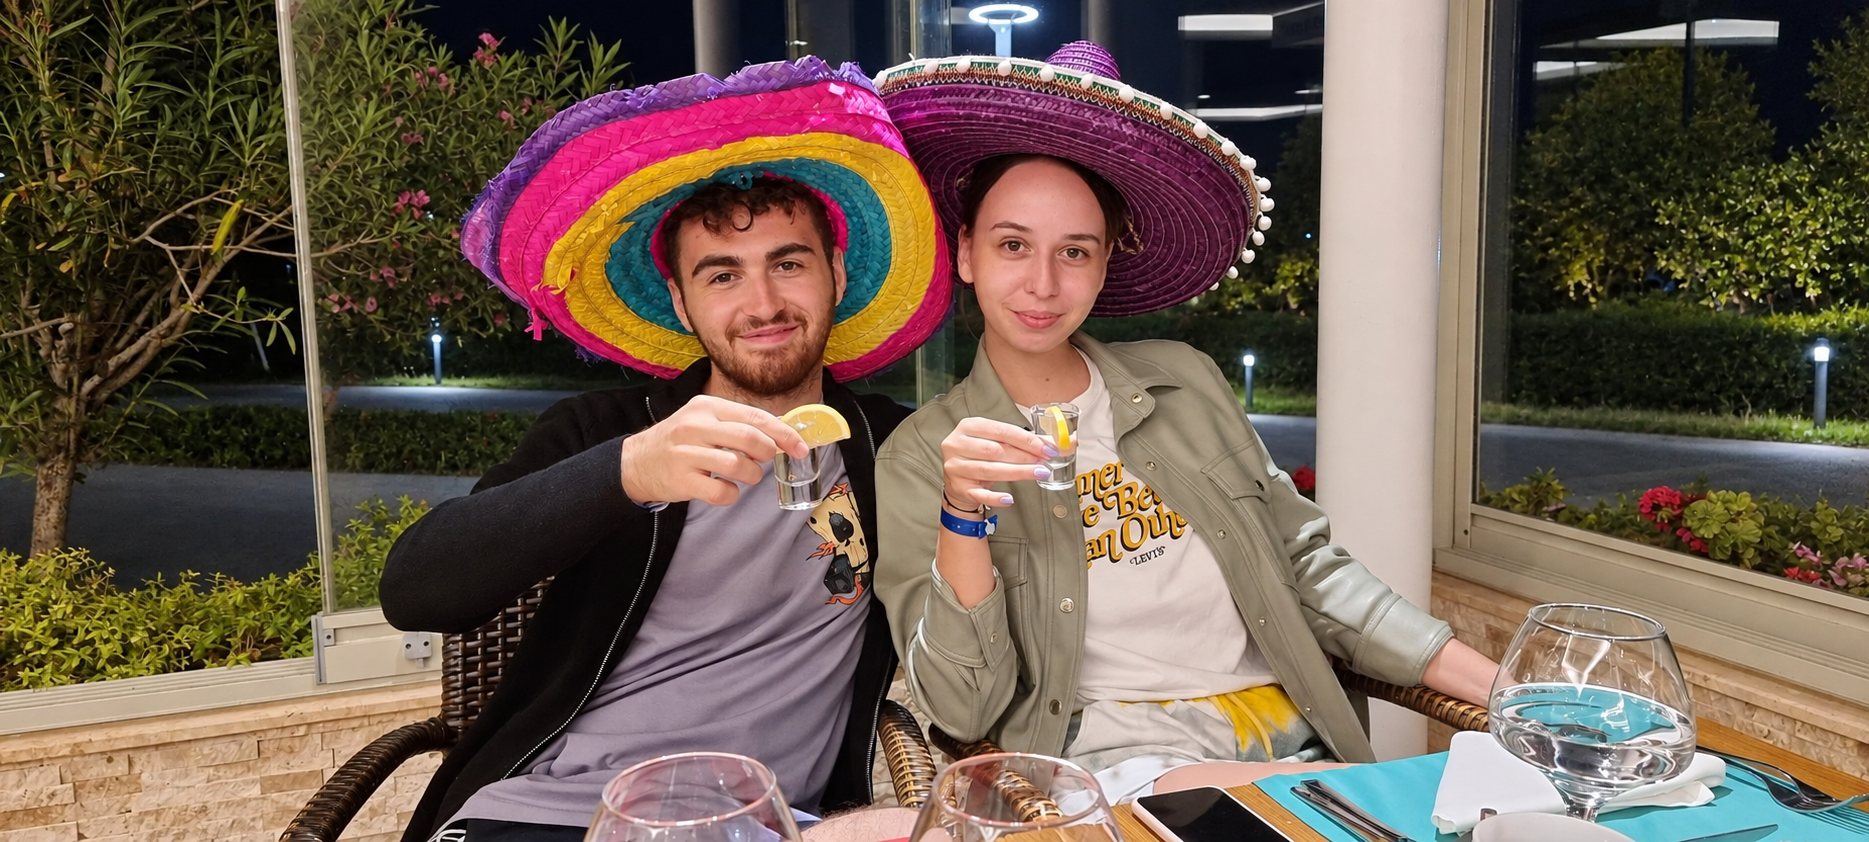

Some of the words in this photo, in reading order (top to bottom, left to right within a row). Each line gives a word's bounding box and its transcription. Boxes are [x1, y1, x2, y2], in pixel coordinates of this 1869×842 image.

[1075, 461, 1124, 503] mer
[1081, 504, 1100, 528] e
[1085, 529, 1124, 569] an
[1130, 545, 1166, 566] LEVI'S
